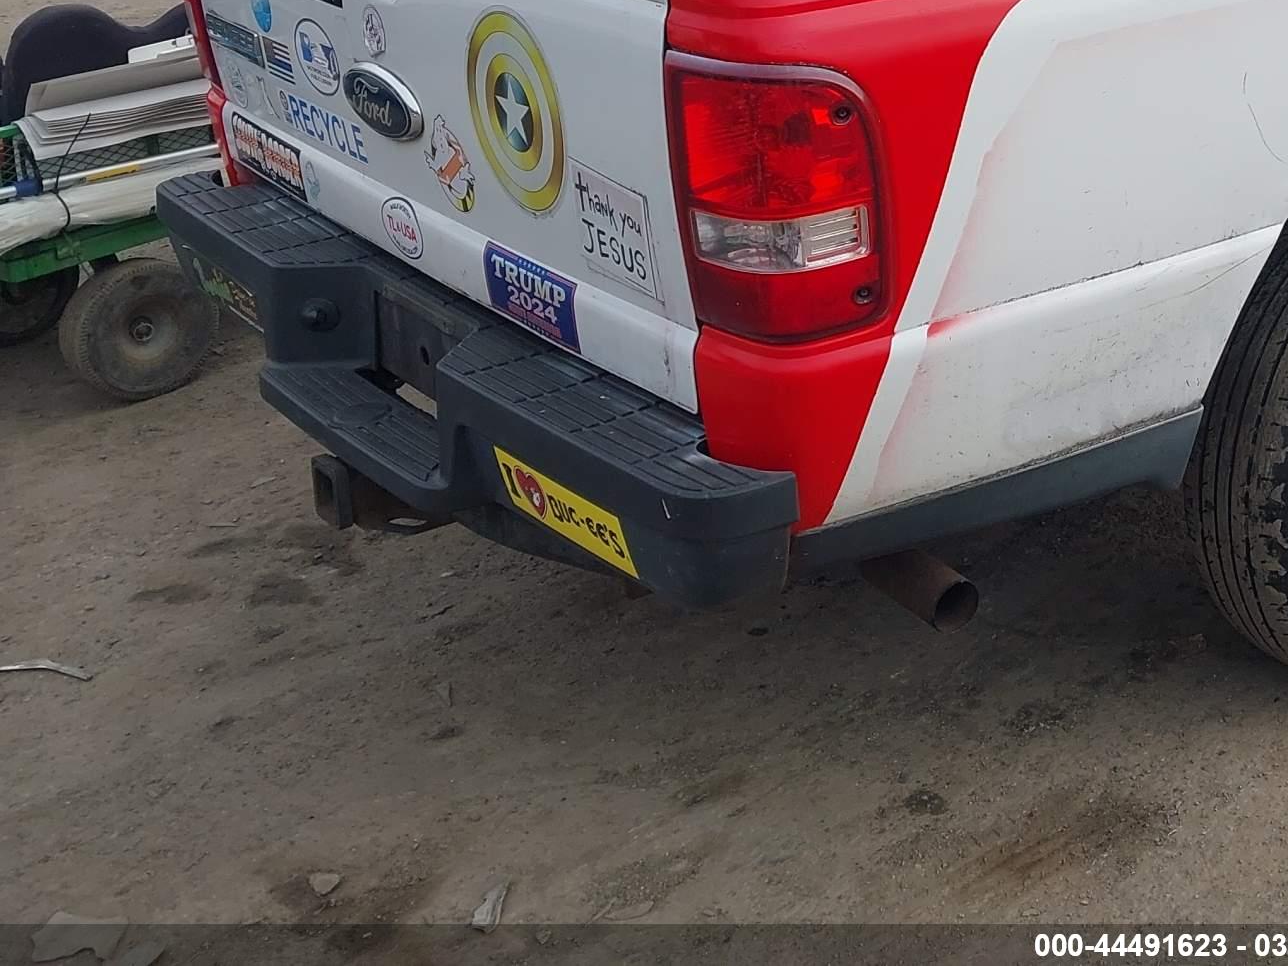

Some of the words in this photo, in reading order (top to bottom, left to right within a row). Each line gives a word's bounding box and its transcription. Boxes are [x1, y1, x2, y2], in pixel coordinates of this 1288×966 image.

[288, 94, 369, 164] RECYCLE
[353, 76, 392, 127] Ford
[574, 171, 619, 232] thank
[618, 212, 643, 238] you
[581, 217, 647, 281] JESUS
[490, 253, 566, 308] TRUMP
[507, 285, 558, 324] 2024
[501, 462, 522, 499] I
